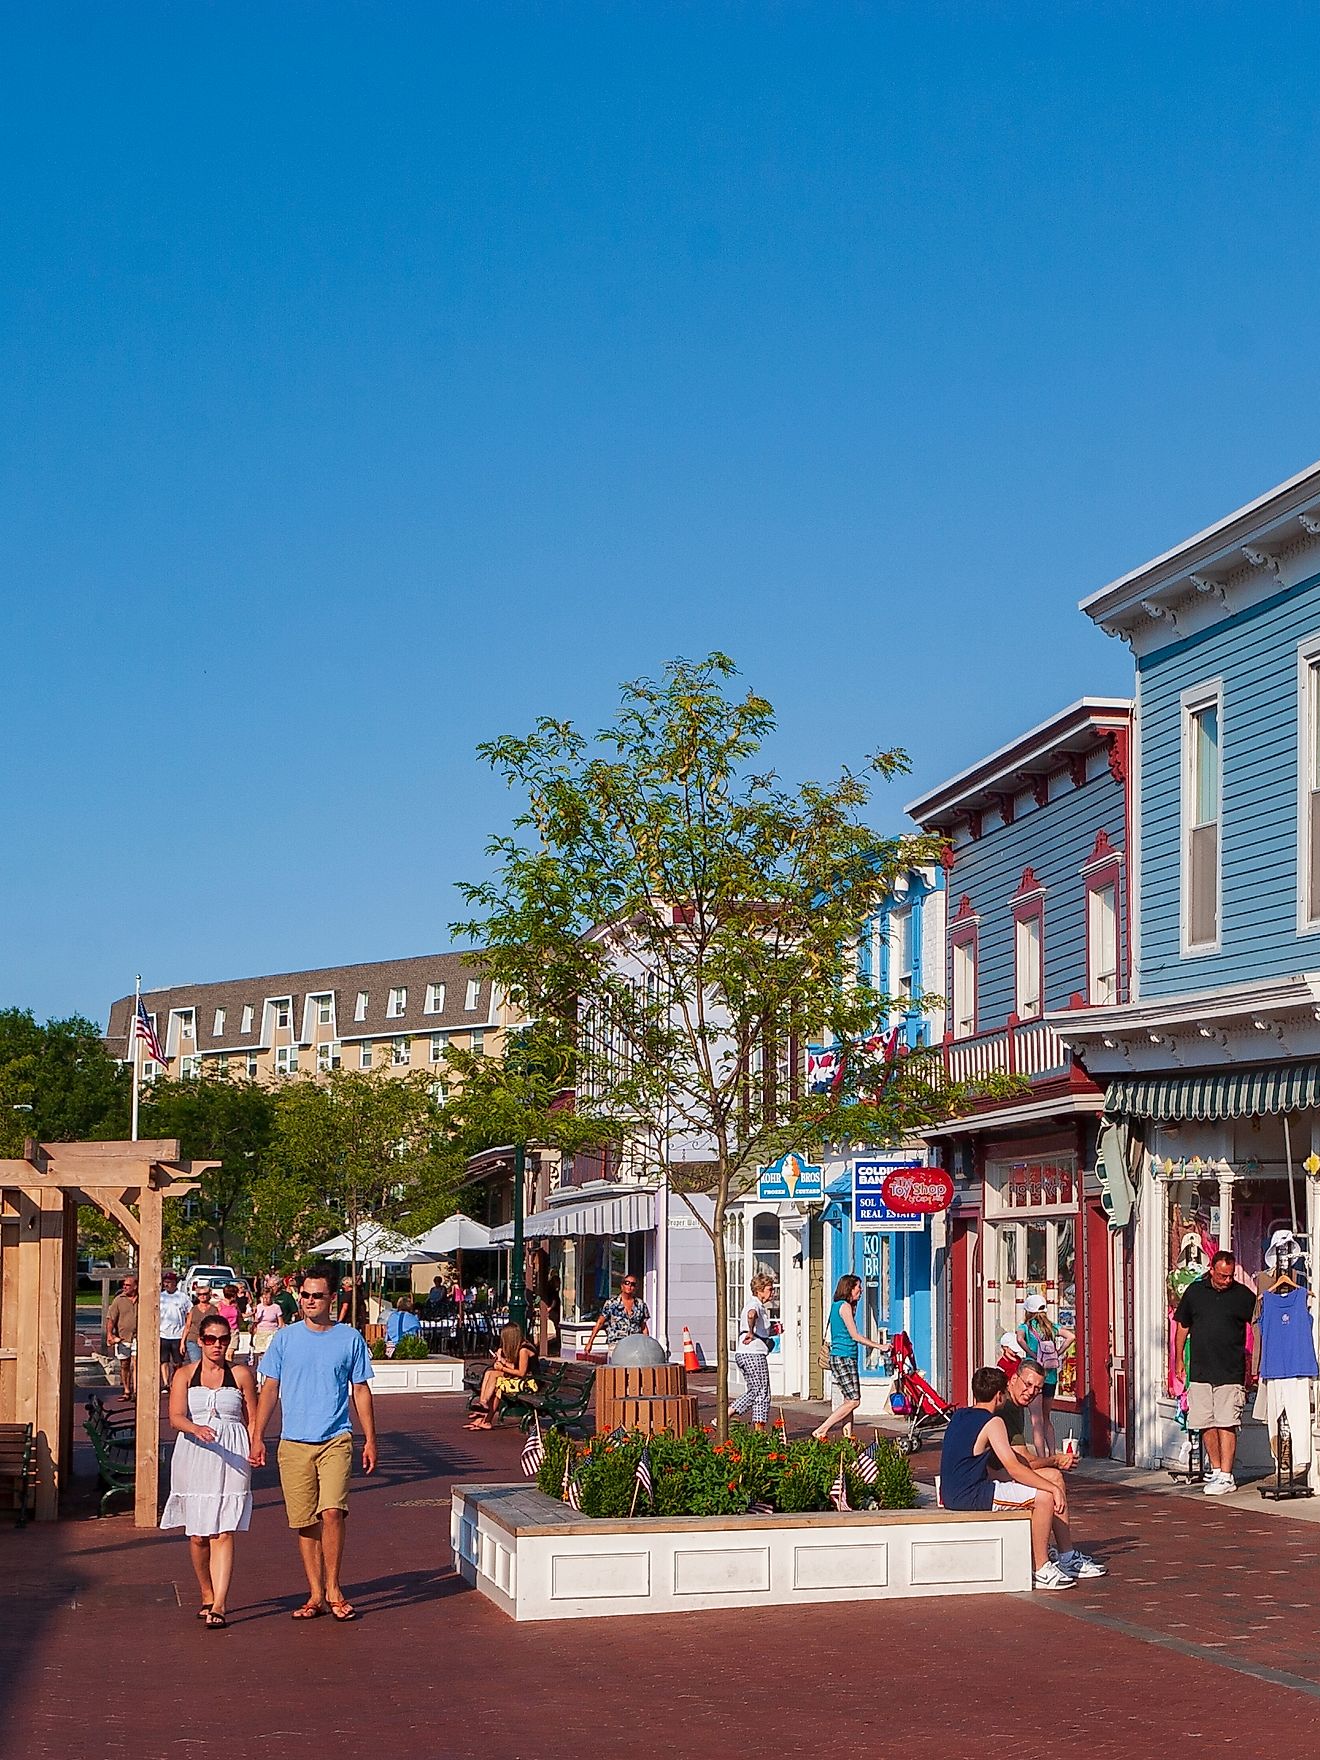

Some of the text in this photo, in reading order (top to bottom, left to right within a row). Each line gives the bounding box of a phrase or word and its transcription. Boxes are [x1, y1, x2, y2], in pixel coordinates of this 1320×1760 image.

[761, 1172, 821, 1183] KOHR BROS
[889, 1182, 946, 1201] Toy Shop
[860, 1198, 877, 1207] SOL
[860, 1210, 883, 1219] REAL
